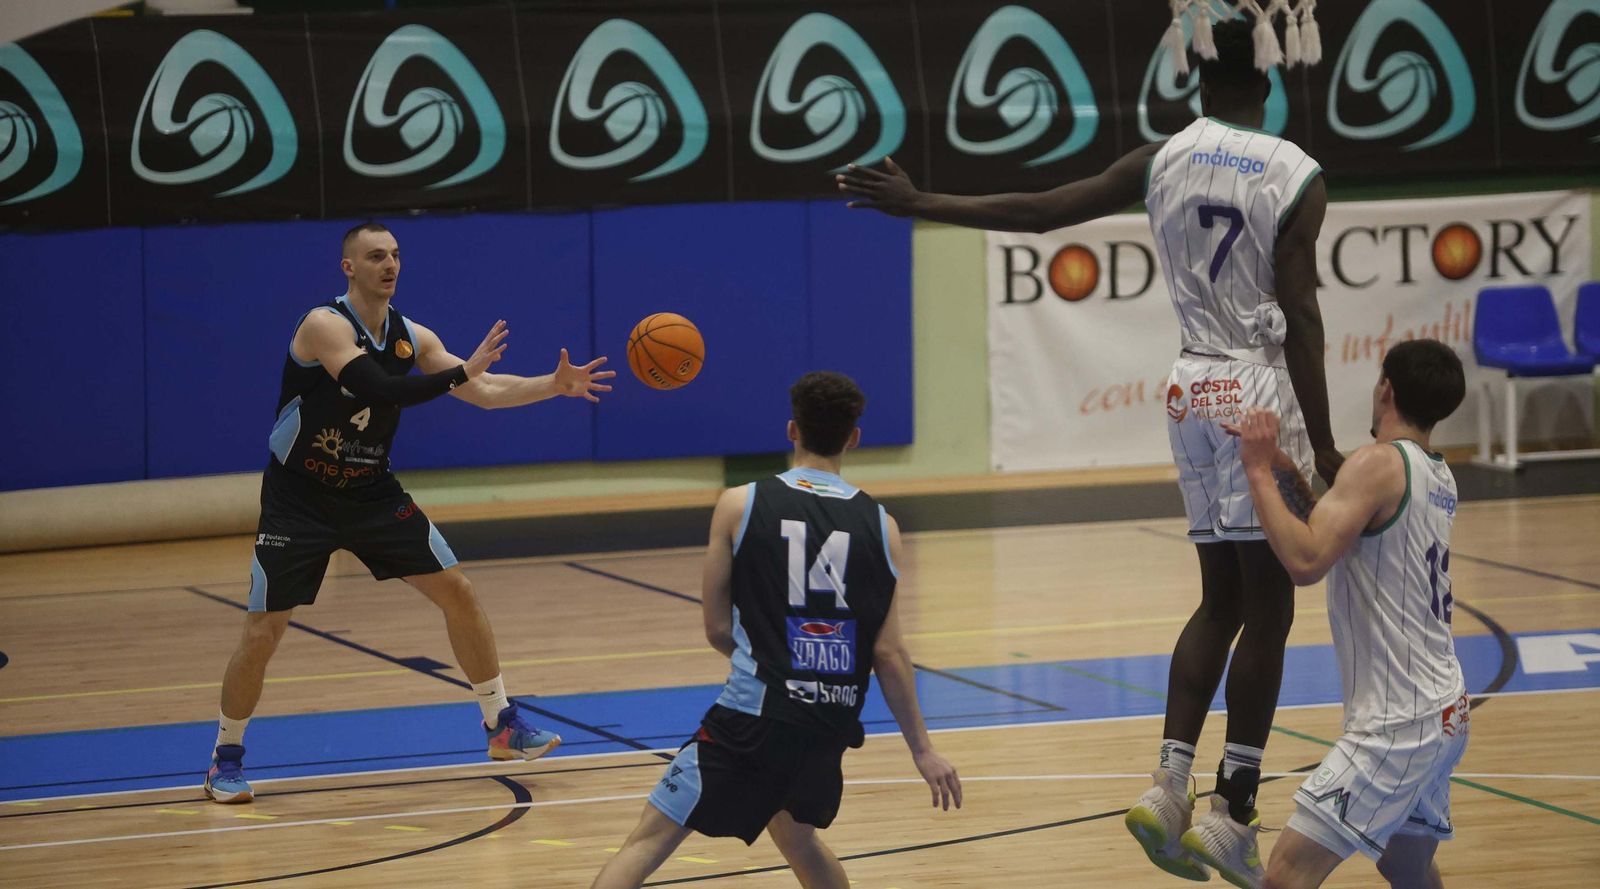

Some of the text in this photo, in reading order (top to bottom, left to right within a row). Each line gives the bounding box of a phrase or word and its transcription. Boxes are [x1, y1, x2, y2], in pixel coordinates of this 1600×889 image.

[1191, 145, 1265, 174] málaga
[1198, 204, 1244, 283] 7
[997, 214, 1581, 306] BOD CTORY
[1190, 379, 1242, 395] COSTA
[1191, 393, 1243, 408] DEL SOL
[349, 406, 371, 432] 4
[780, 518, 851, 611] 14
